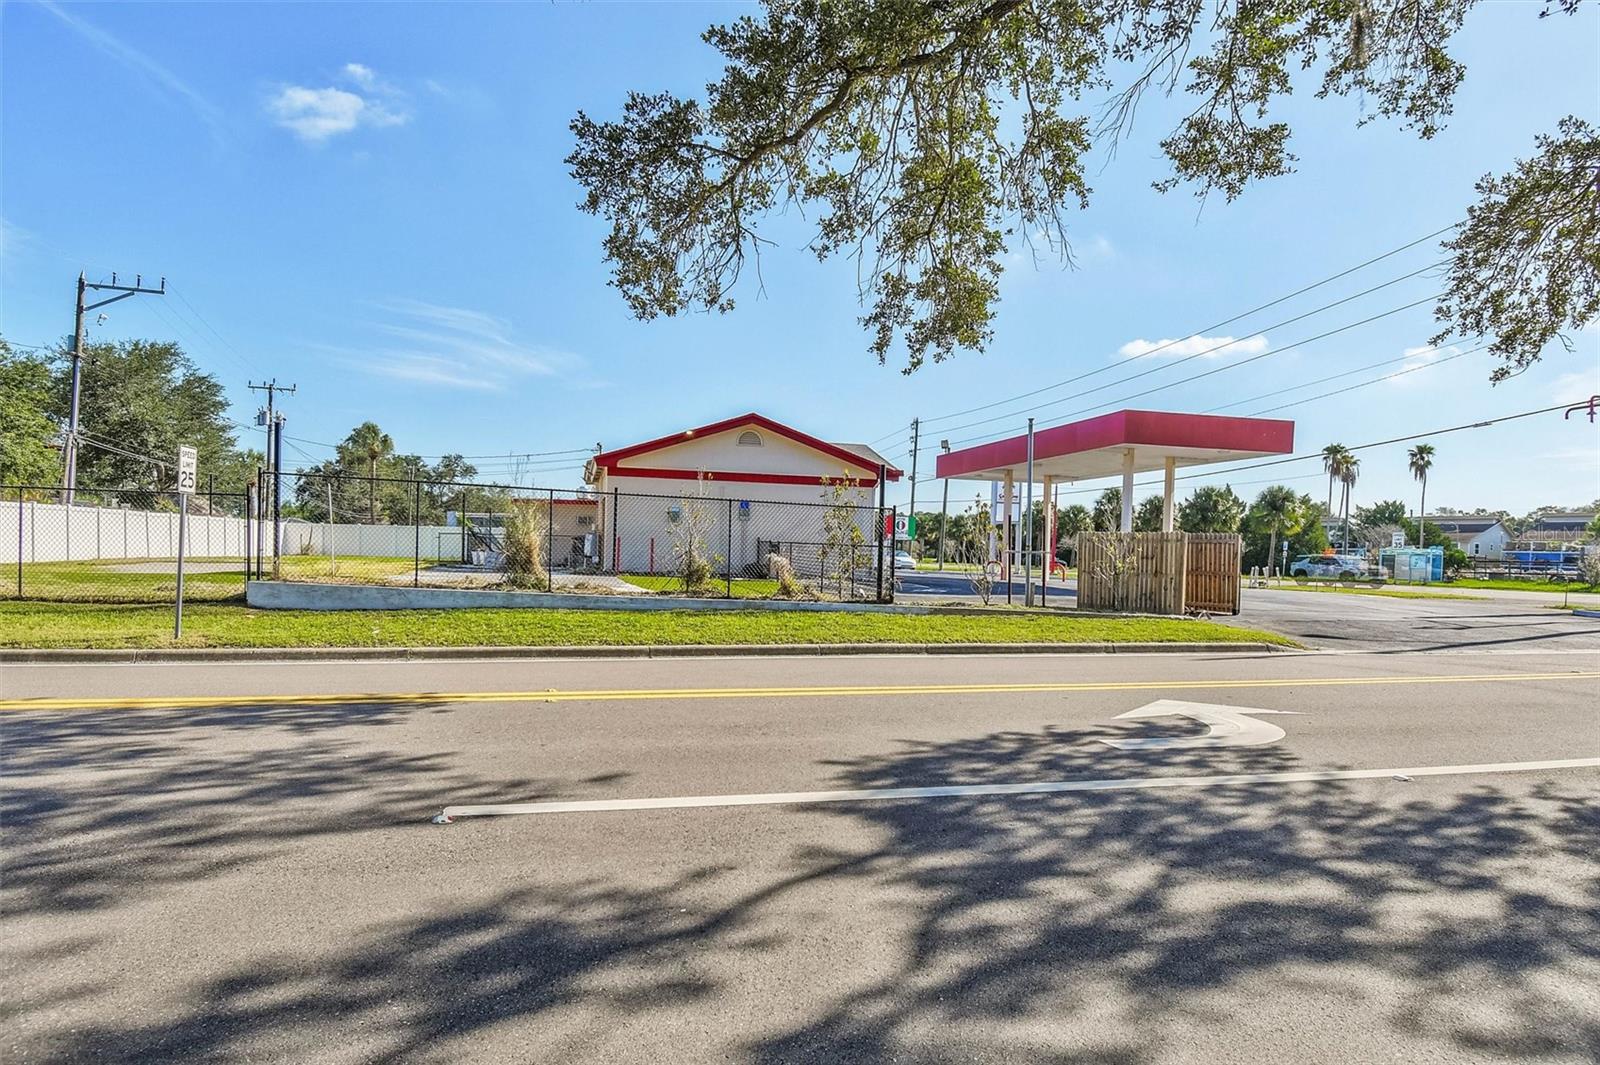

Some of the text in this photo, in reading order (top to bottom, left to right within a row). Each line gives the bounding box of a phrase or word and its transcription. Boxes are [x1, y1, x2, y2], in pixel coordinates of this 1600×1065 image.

[182, 450, 195, 460] SPEED
[182, 460, 194, 468] LIMIT
[181, 470, 194, 488] 25
